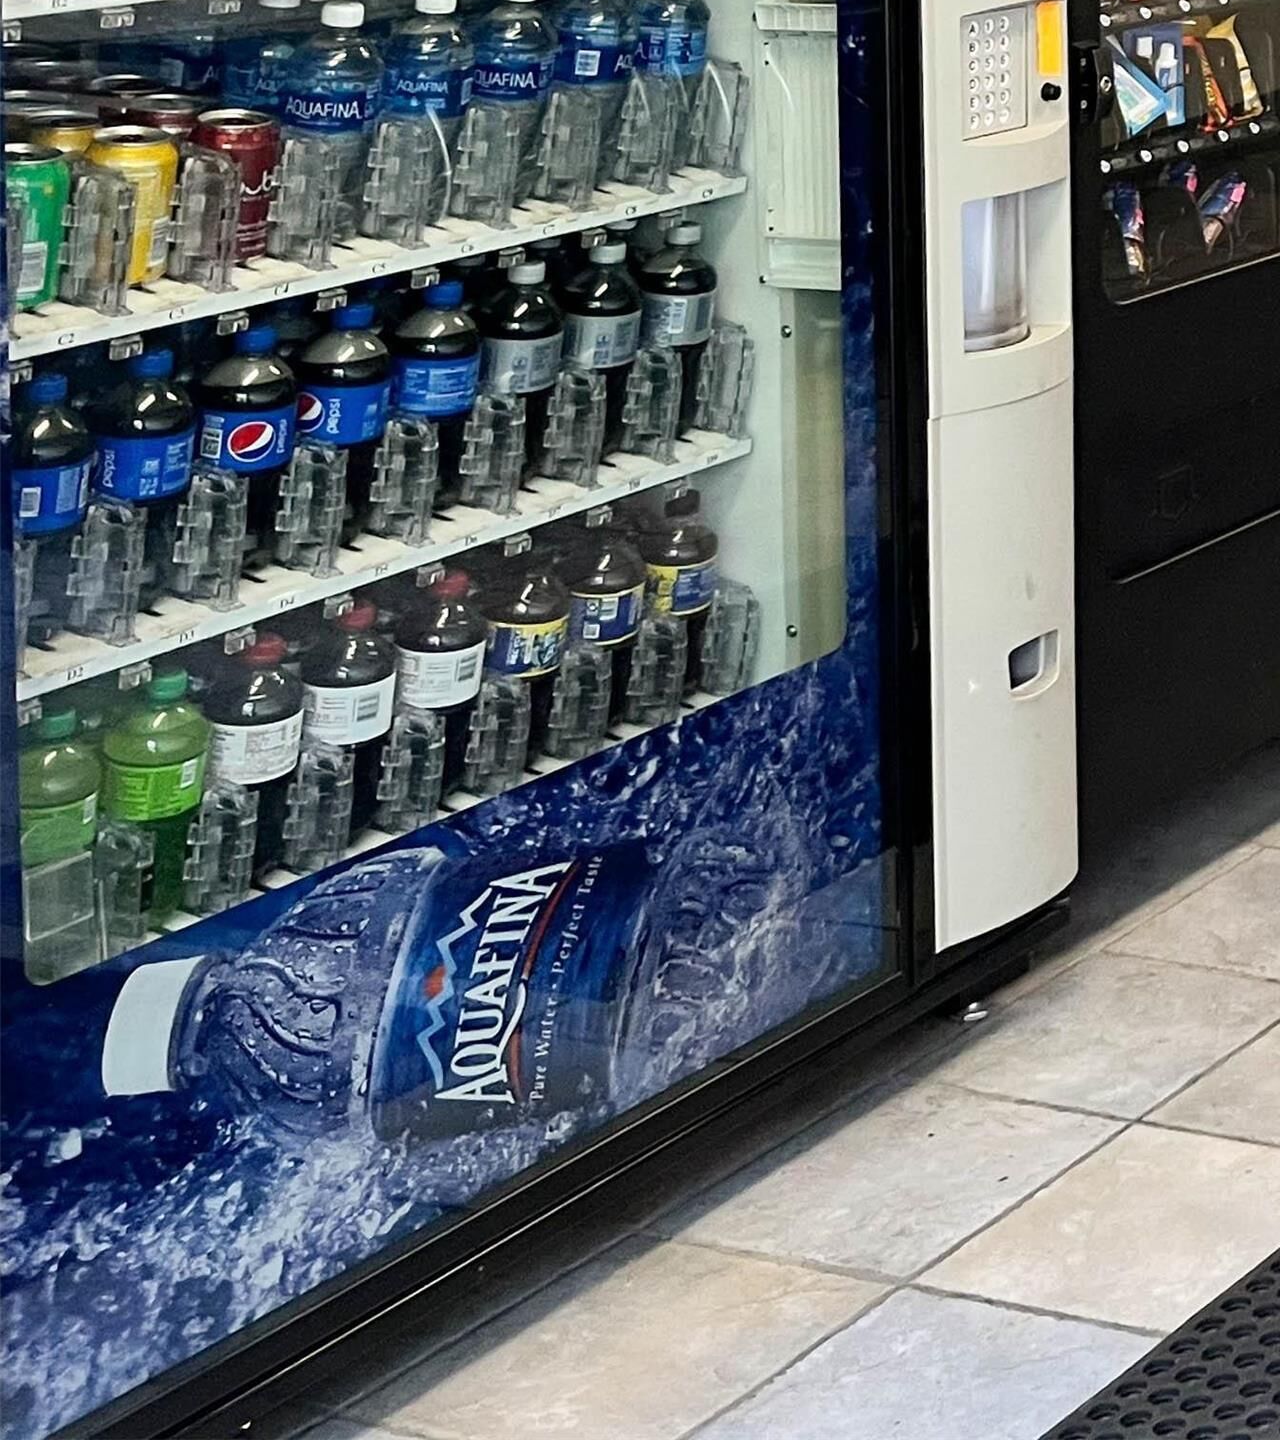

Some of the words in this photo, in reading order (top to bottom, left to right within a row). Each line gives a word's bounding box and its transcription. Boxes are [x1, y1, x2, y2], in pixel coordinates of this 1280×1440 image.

[396, 79, 449, 94] AQUAFINA
[473, 69, 538, 89] QUAFINA
[285, 96, 362, 119] AQUAFINA
[58, 333, 74, 345] C2
[326, 398, 342, 434] pepsi
[102, 449, 116, 489] pepsi
[577, 855, 603, 895] Taste
[551, 903, 585, 974] Perfect
[435, 860, 574, 1104] AQUAFINA
[535, 998, 557, 1058] Water
[529, 1065, 547, 1101] Pure
